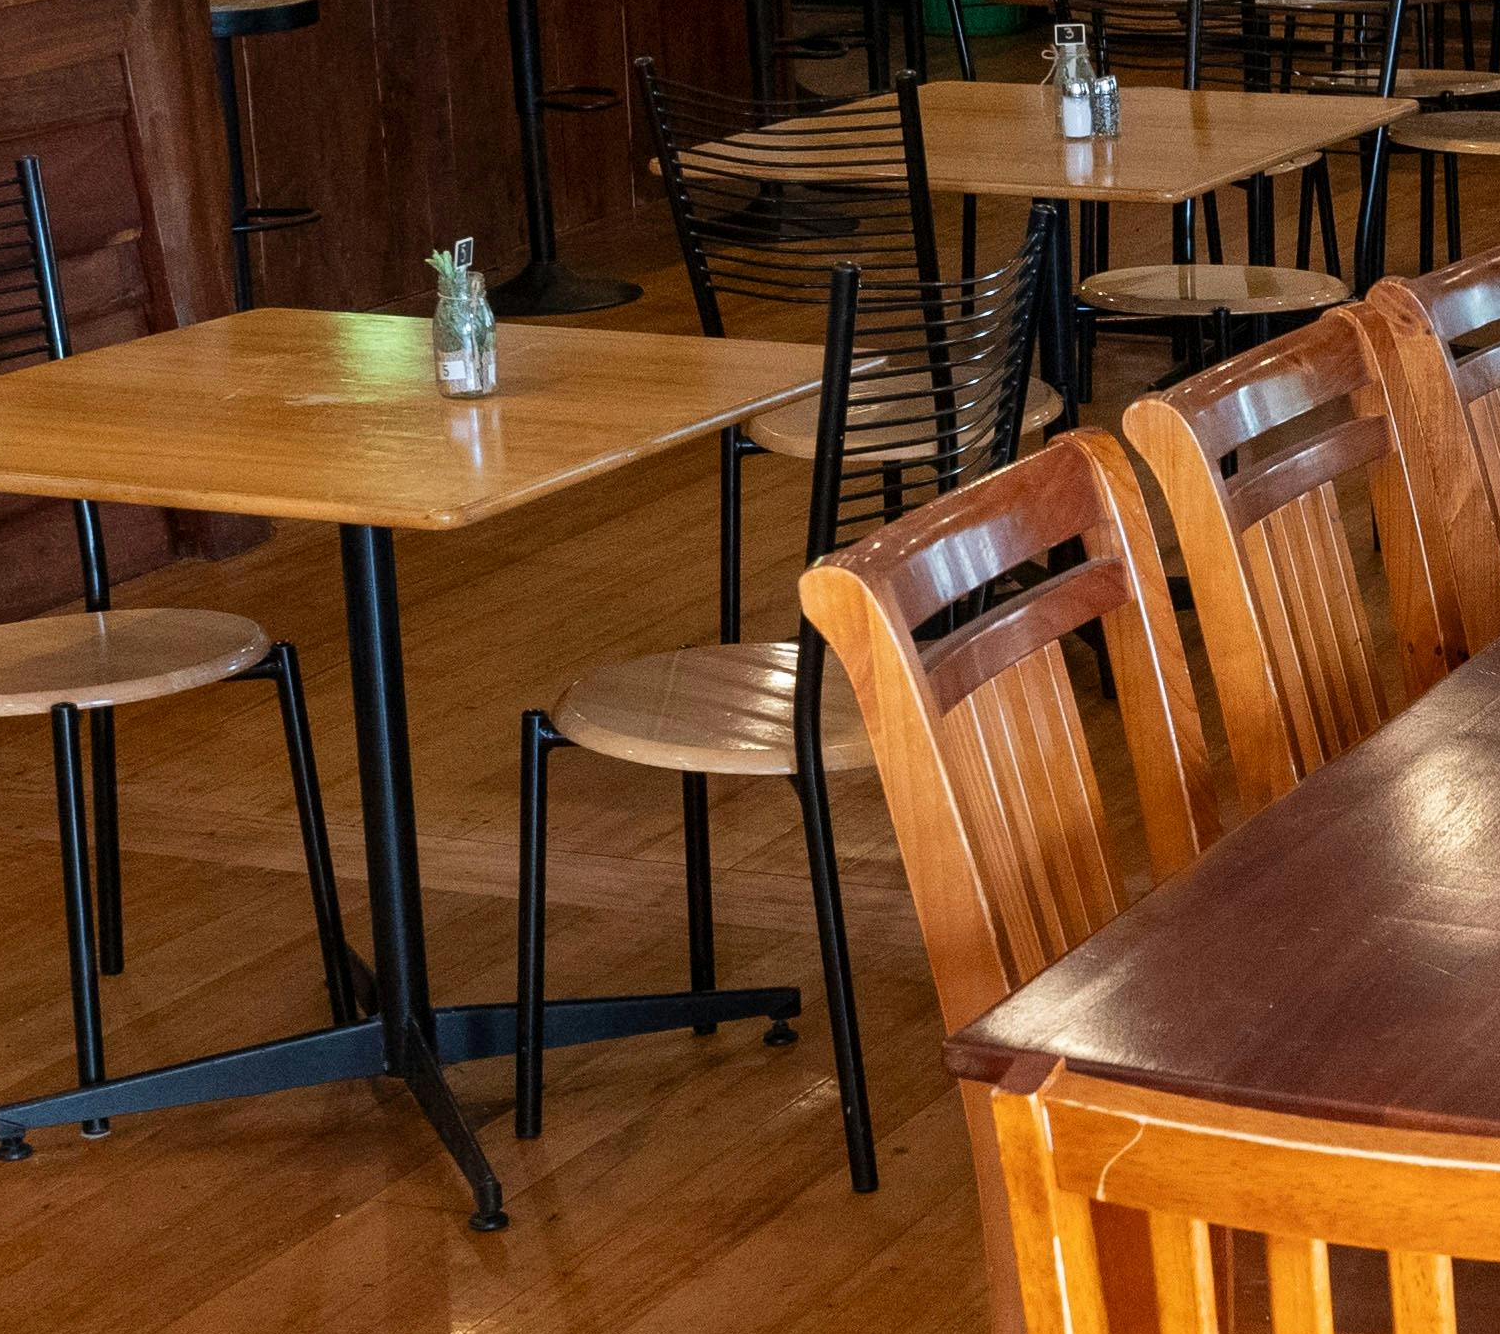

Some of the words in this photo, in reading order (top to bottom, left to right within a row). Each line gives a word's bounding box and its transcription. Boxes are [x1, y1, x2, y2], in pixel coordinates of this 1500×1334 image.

[1063, 27, 1074, 40] 3
[459, 244, 467, 263] 5
[443, 364, 450, 378] 5
